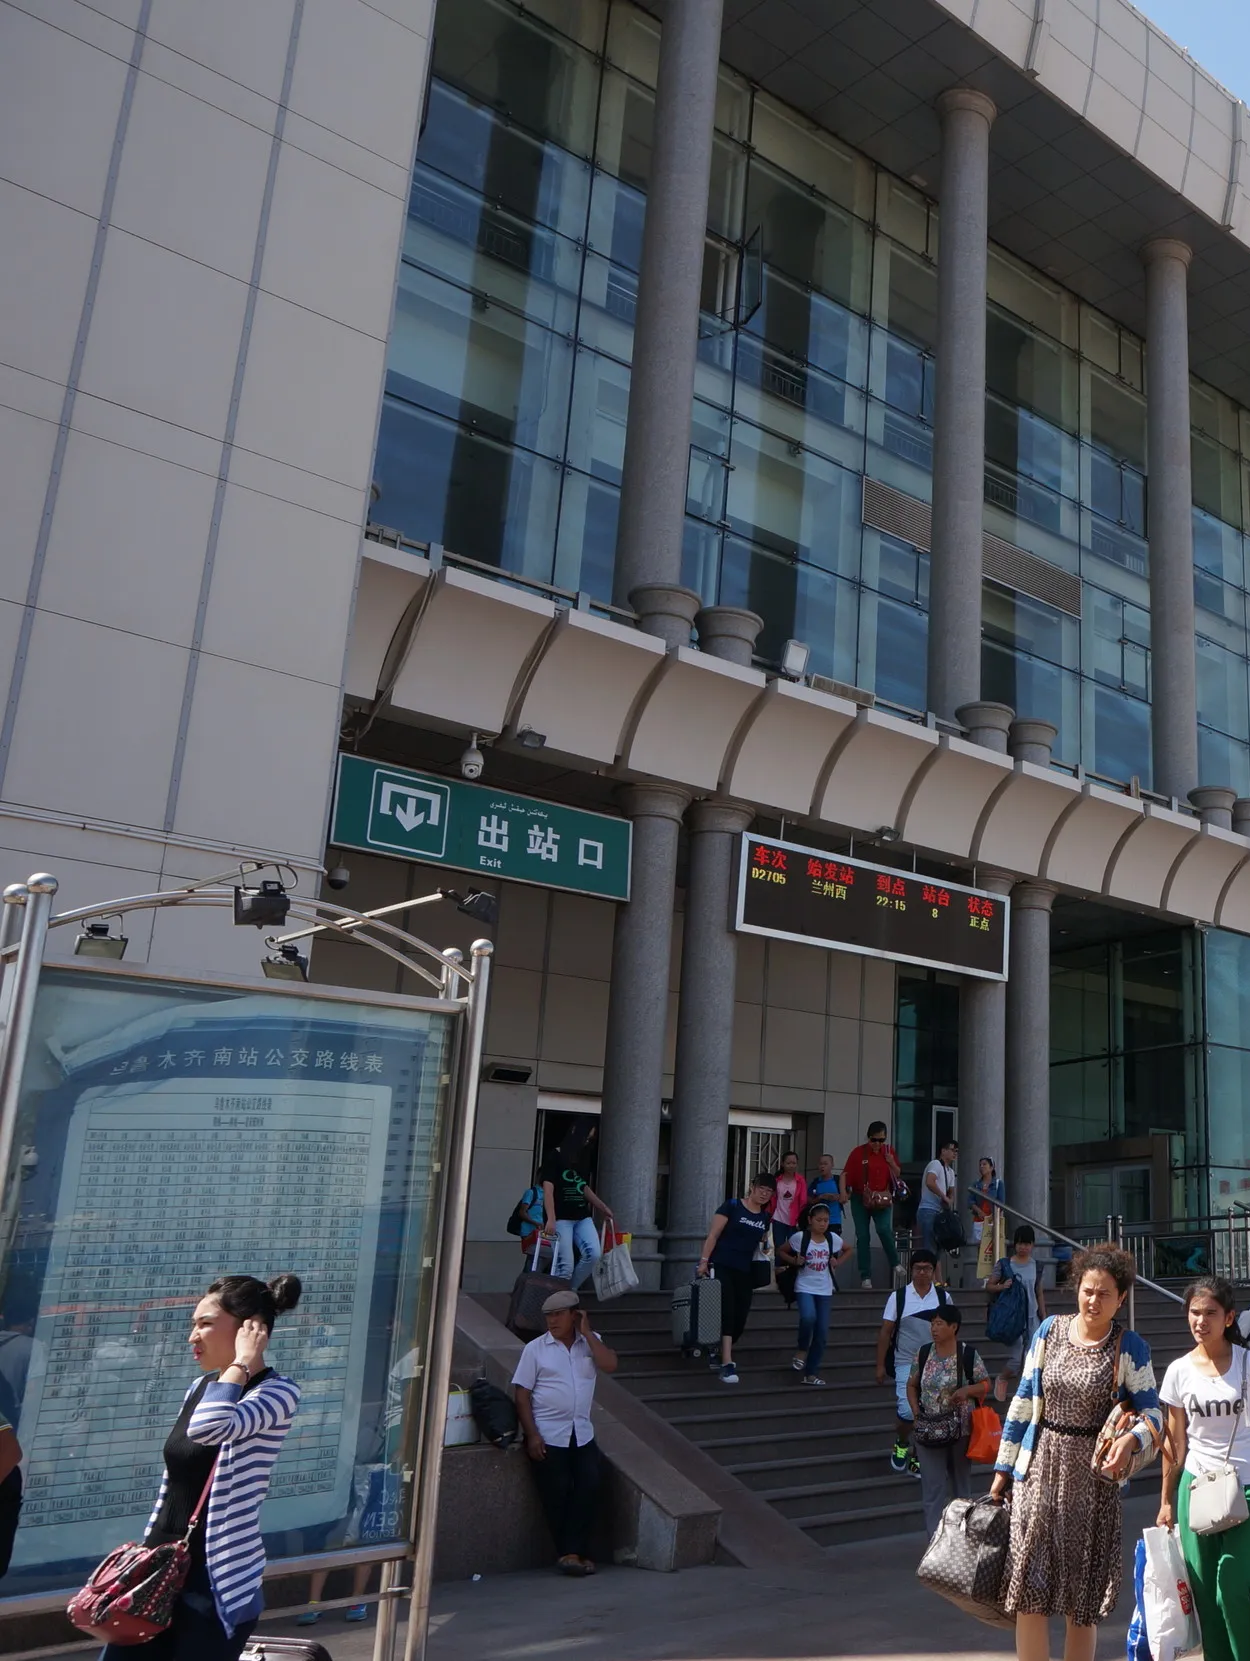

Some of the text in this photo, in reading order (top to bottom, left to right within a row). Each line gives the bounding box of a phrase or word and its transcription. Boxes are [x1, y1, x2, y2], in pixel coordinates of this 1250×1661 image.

[477, 814, 604, 870] 出站口
[479, 855, 502, 869] Exit
[752, 866, 990, 931] D2705 兰州西 22:15 8 正点
[753, 845, 994, 917] 车次 始发站 到点 站台 状态
